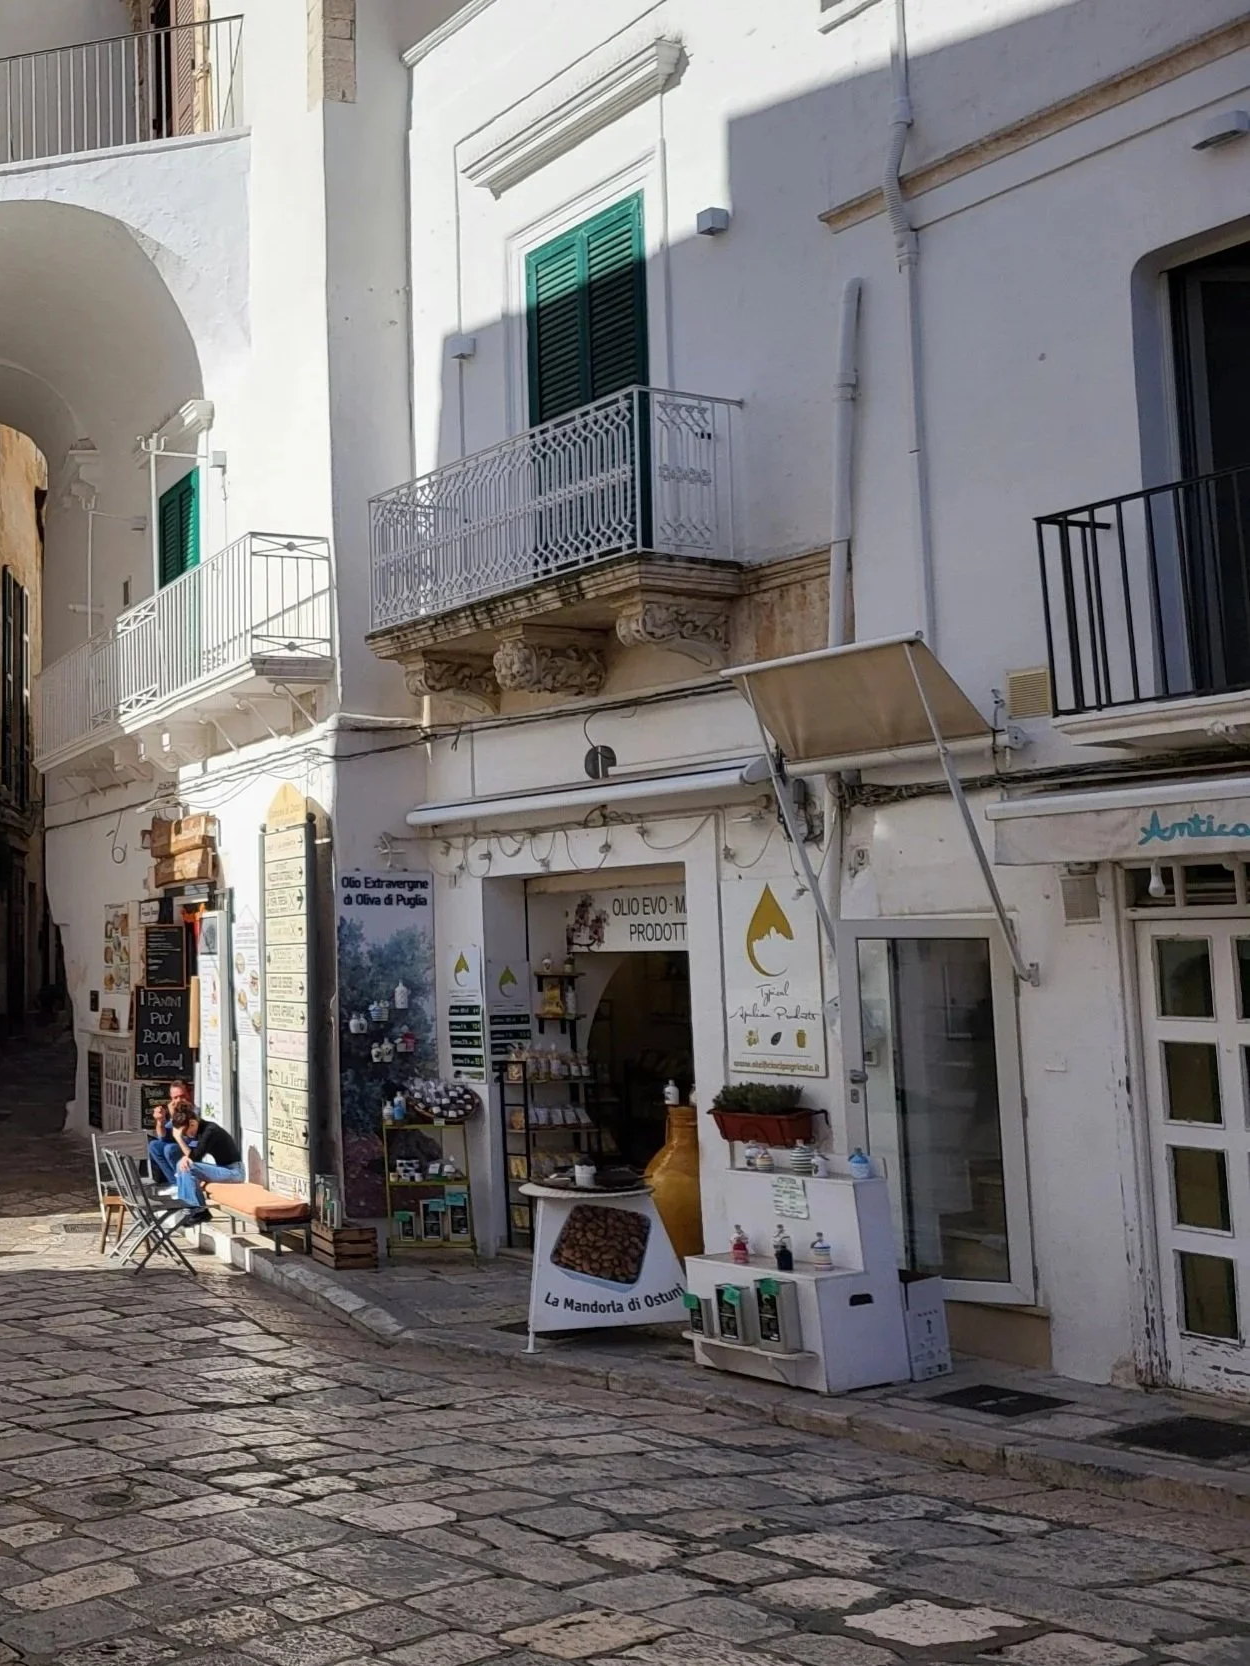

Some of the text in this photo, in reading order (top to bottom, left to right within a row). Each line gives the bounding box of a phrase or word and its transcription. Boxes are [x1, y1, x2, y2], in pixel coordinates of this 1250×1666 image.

[341, 876, 429, 892] Olio Extravergine
[343, 893, 428, 909] di Oliva di Puglia
[612, 897, 640, 916] OLIO
[642, 896, 667, 915] EVO
[544, 1282, 686, 1314] La Mandorla di Ostuni
